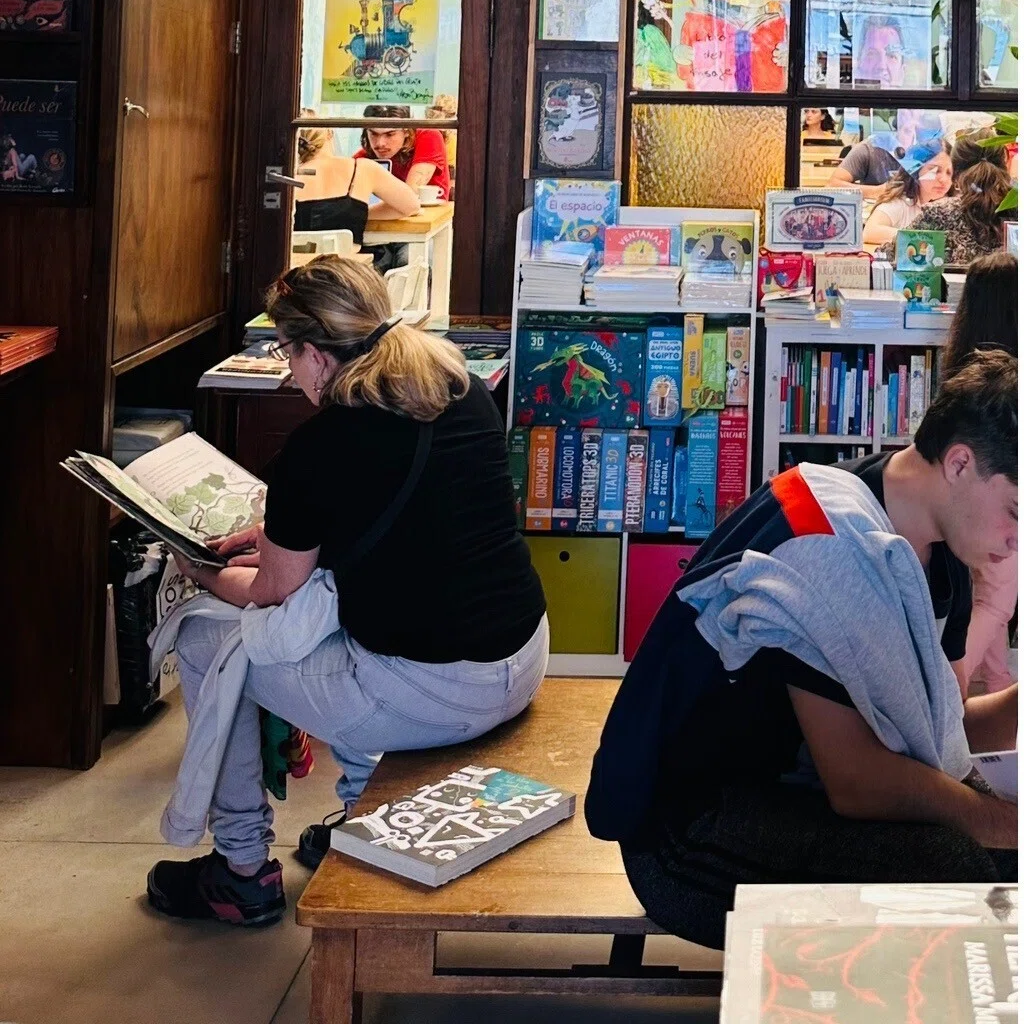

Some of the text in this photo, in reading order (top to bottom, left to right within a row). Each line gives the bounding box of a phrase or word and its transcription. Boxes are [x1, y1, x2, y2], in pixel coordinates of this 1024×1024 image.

[549, 199, 603, 213] El espacio
[618, 229, 665, 246] VENTANAS
[530, 336, 544, 347] 3D
[650, 352, 680, 360] EGIPTO
[629, 444, 646, 459] 3D
[534, 447, 550, 500] SUBMARINO
[560, 446, 575, 500] LOCOMOTORA
[579, 442, 599, 526] TRICERATOPS 3D
[604, 449, 619, 502] TITANIC 3D
[652, 459, 662, 495] ARRECIFES
[659, 461, 670, 496] DE CORAL
[963, 941, 997, 1007] MARISSA
